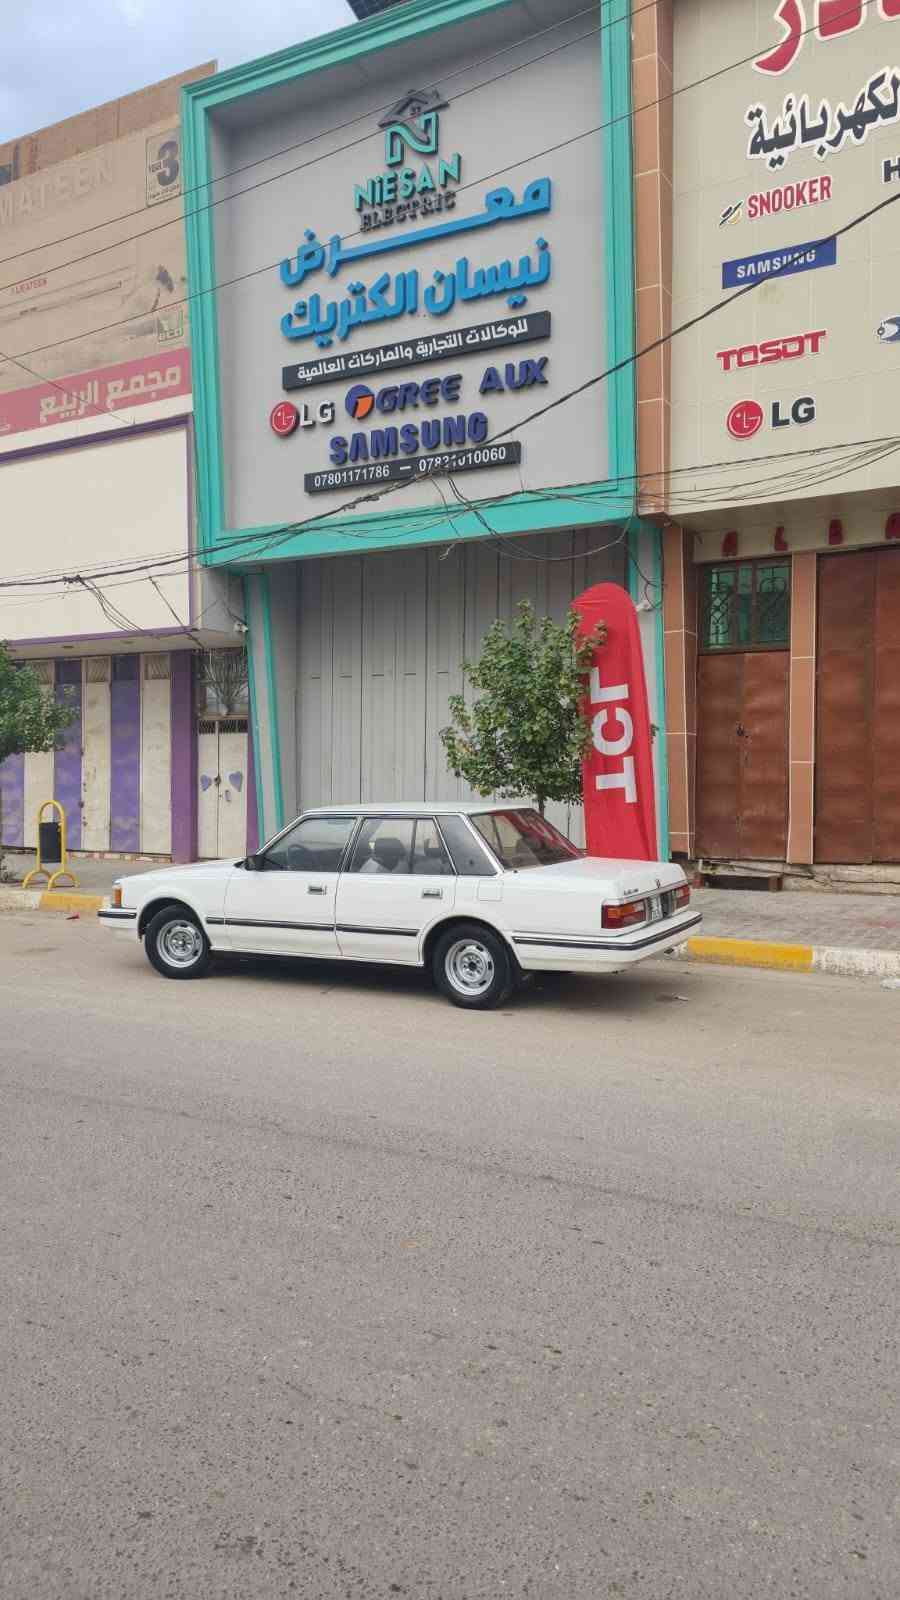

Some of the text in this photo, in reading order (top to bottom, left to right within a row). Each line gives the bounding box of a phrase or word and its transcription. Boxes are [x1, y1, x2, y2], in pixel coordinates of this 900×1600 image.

[360, 191, 457, 231] ELECTRIC
[748, 176, 831, 219] SNOOKER
[279, 237, 552, 348] نيسان الكتريك
[297, 318, 528, 381] للوكالات التجارية والماركات العالمية
[717, 330, 826, 371] TOSOT
[39, 365, 182, 423] مجمع الربيع
[300, 356, 549, 429] LG GREE AUX
[772, 397, 816, 427] LG
[330, 411, 489, 466] SAMSUNG
[314, 464, 390, 488] 07801171786
[590, 667, 638, 804] TCL
